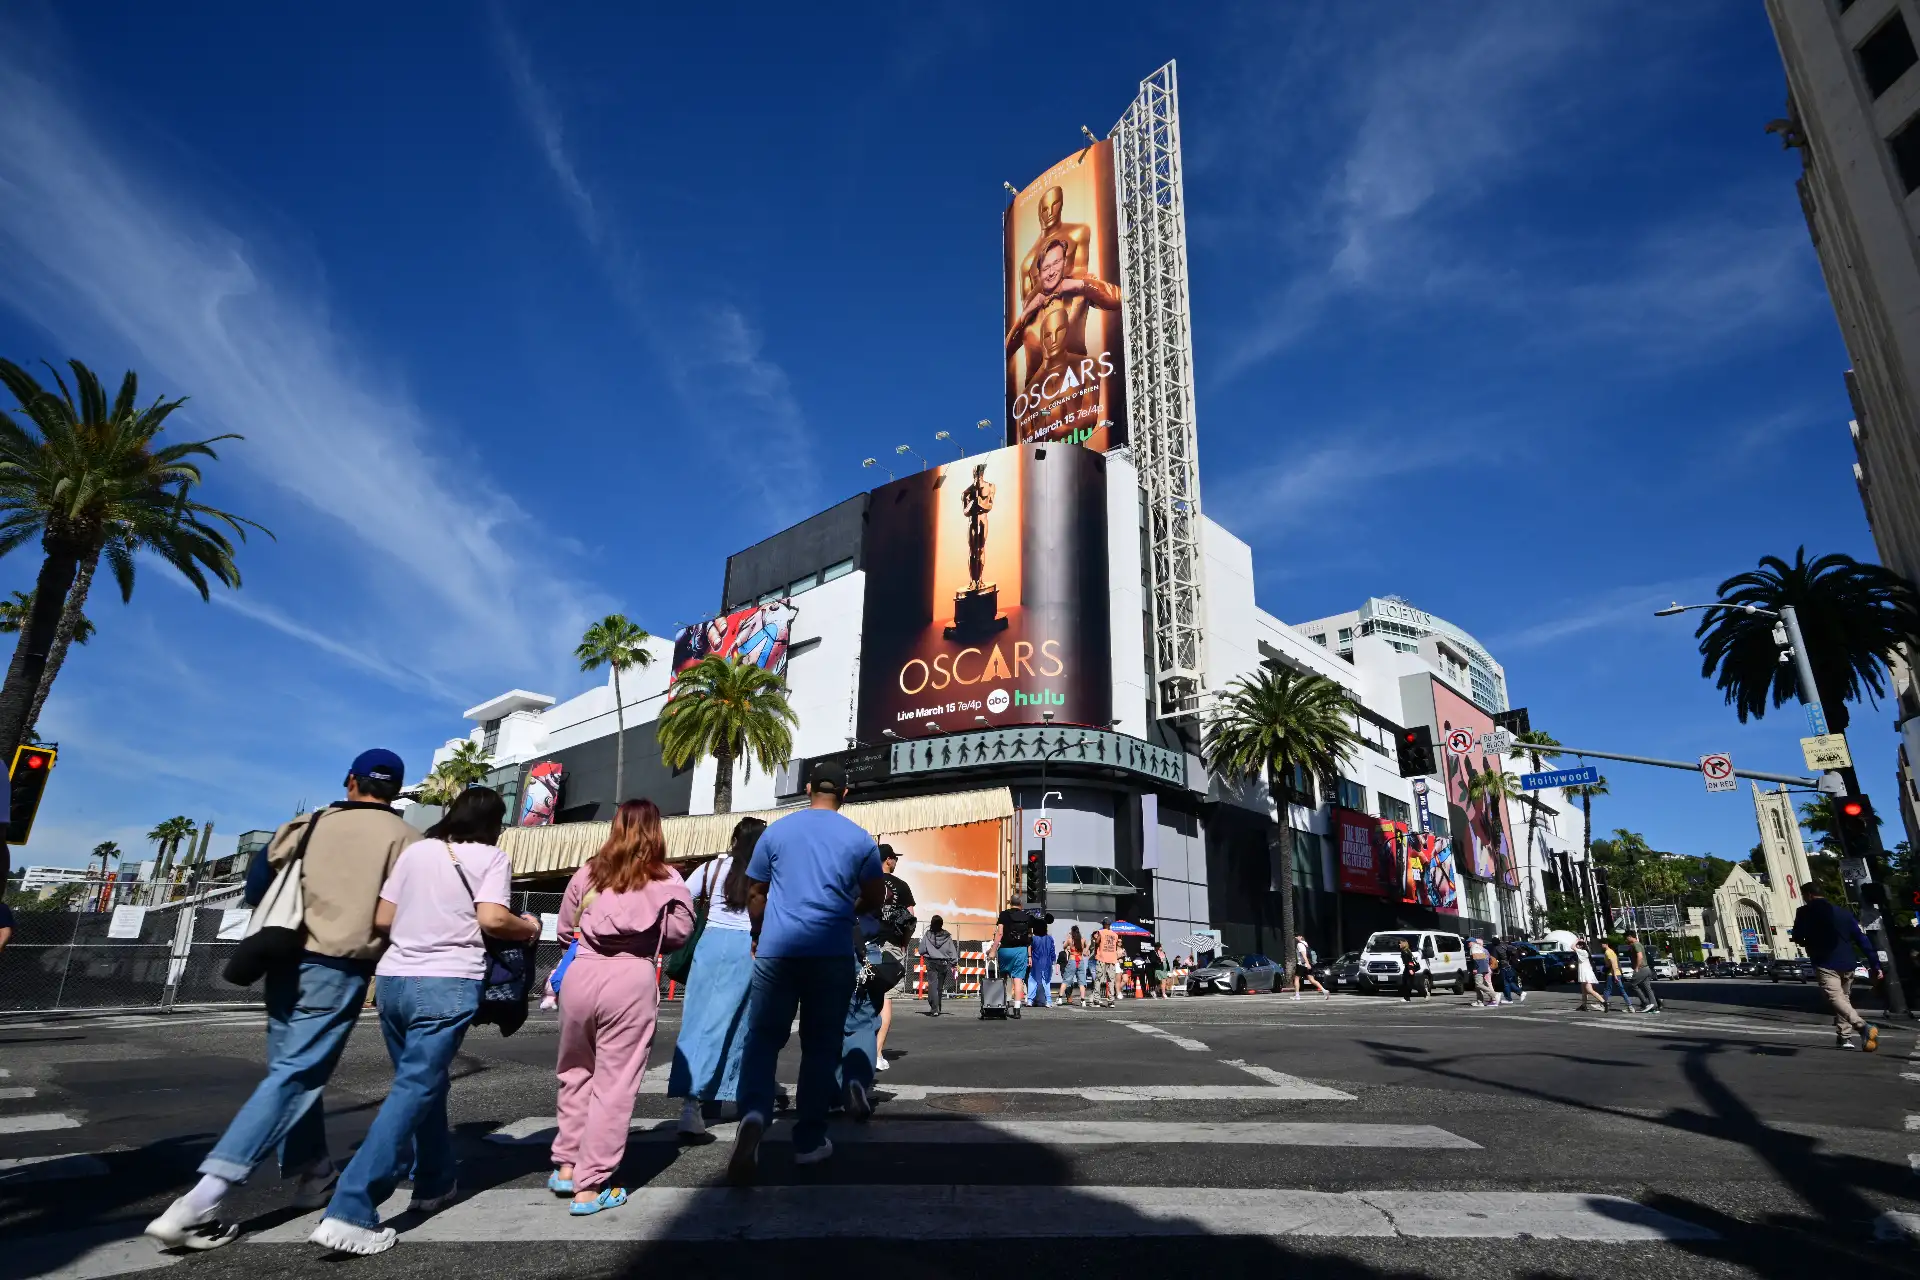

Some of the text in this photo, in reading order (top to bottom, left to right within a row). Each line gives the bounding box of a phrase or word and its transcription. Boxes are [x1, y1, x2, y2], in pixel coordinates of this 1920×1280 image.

[1012, 351, 1114, 420] OSCARS
[1020, 411, 1039, 427] HOSTED
[1048, 396, 1071, 410] CONAN
[1072, 385, 1100, 399] O'BRIEN
[1035, 419, 1063, 440] March
[1064, 412, 1076, 425] 15
[1077, 404, 1105, 421] 7e/4p
[1048, 427, 1093, 445] ulu
[1379, 601, 1431, 625] LOEWS
[900, 640, 1064, 695] OSCARS
[988, 696, 1008, 706] abc
[1015, 689, 1065, 706] hulu
[897, 700, 982, 722] Live March 15 7e/4p
[1494, 733, 1505, 741] NOT
[1529, 771, 1589, 787] Hollywood
